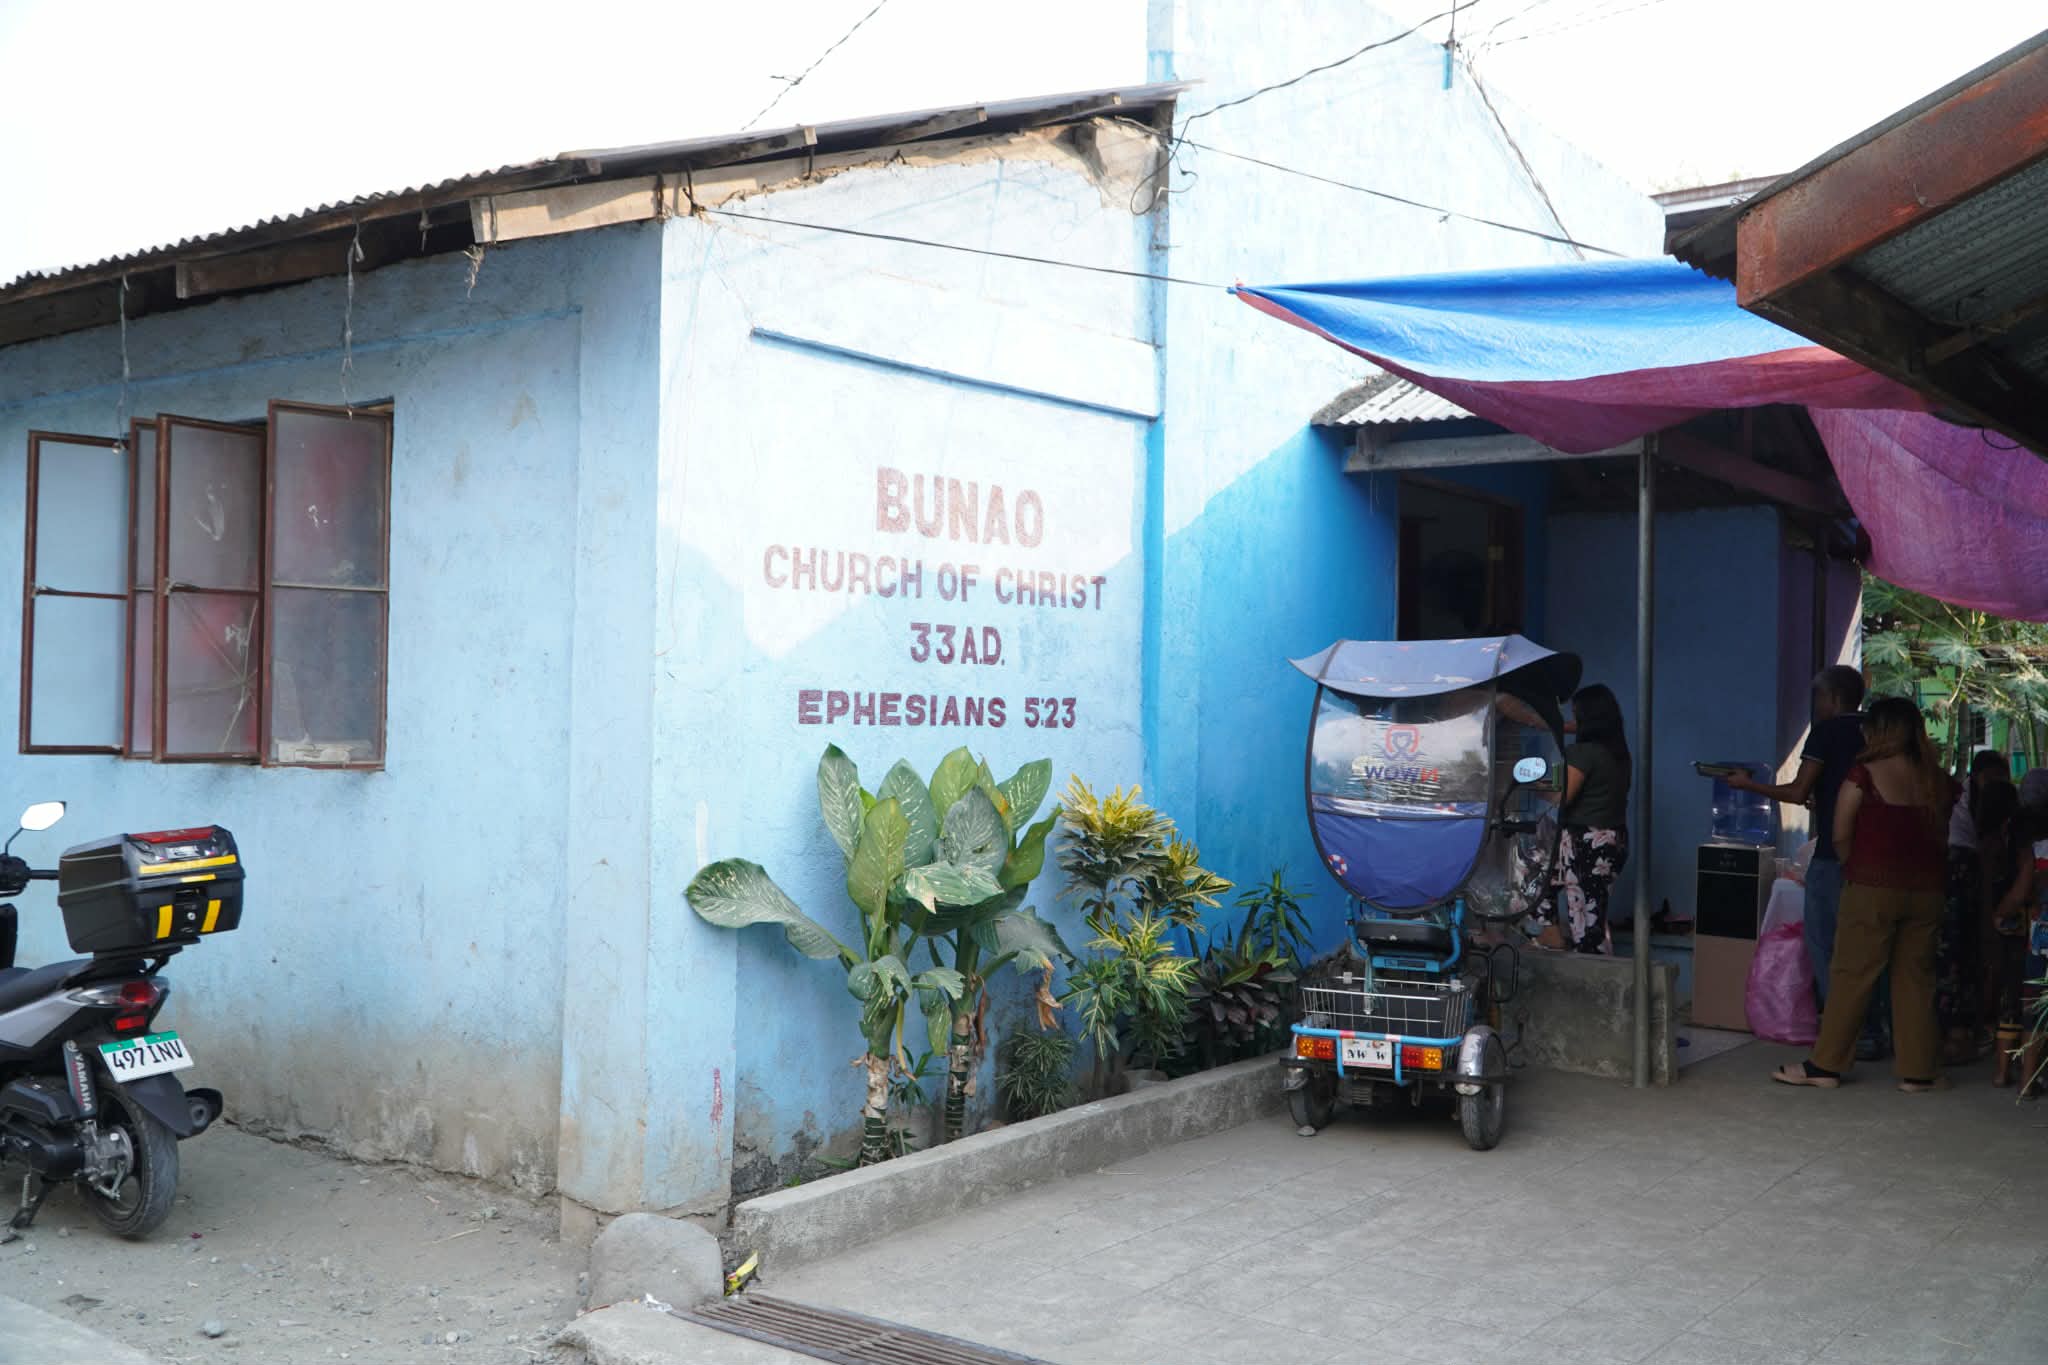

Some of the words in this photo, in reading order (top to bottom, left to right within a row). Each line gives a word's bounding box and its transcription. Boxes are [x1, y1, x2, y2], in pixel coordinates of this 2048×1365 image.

[876, 467, 1044, 549] BUNAO
[763, 544, 922, 598] CHURCH
[937, 563, 980, 602] OF
[995, 567, 1106, 610] CHRIST
[798, 689, 1007, 728] EPHESIANS
[75, 1053, 92, 1111] YAMAHA
